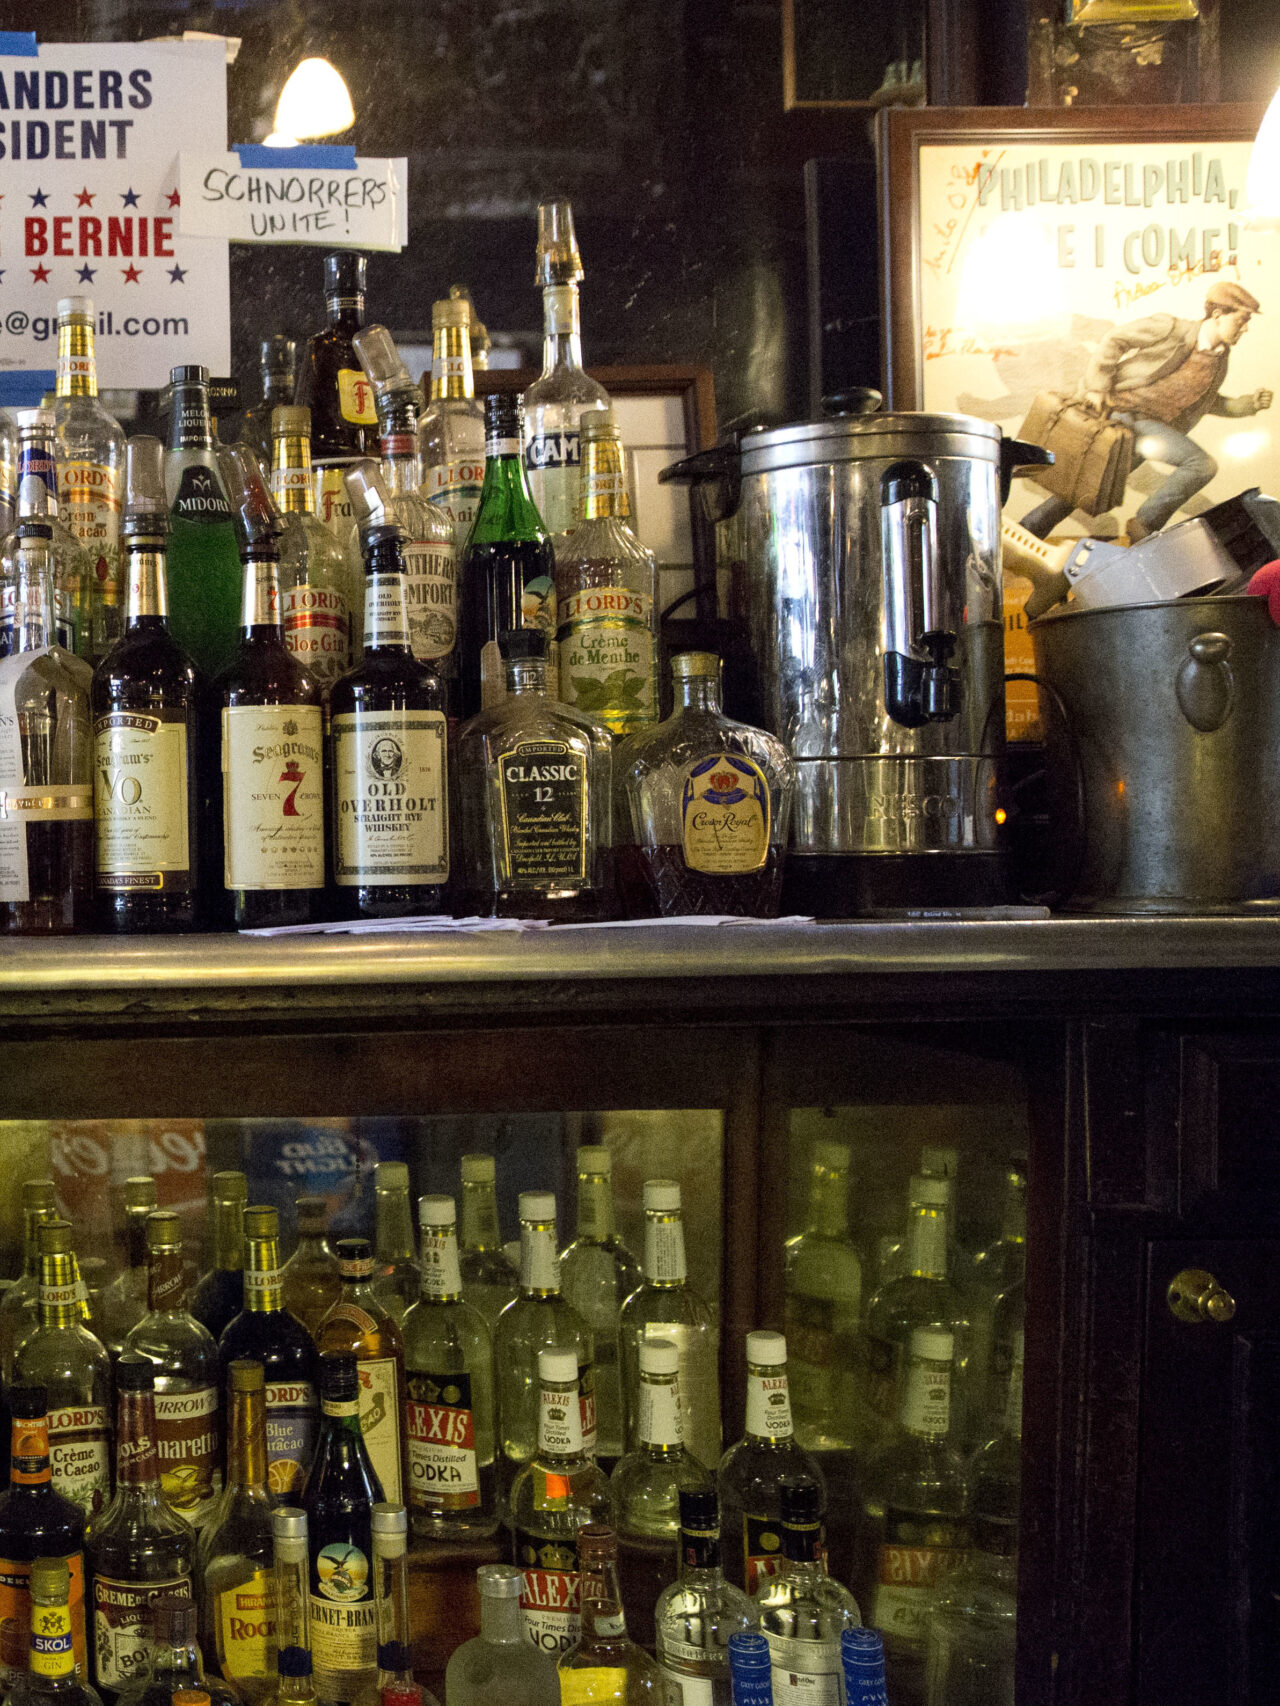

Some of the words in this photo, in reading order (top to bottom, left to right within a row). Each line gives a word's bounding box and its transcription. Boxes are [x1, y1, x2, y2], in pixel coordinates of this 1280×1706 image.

[202, 168, 387, 210] SCHNORRERS
[24, 216, 175, 257] BERNIE
[1123, 222, 1239, 275] COME!
[437, 465, 485, 488] LLOR
[178, 498, 231, 512] MIDORI
[406, 554, 455, 580] UTHERN
[406, 583, 454, 605] MFORT
[321, 634, 344, 652] Gin
[580, 634, 629, 650] Crème
[587, 651, 640, 665] Menthe
[520, 671, 537, 684] 12
[507, 765, 577, 782] CLASSIC
[251, 793, 281, 801] SEVEN
[279, 772, 306, 816] 7
[368, 783, 406, 797] OLD
[534, 787, 554, 802] 12
[341, 798, 437, 813] OVERHOLT
[354, 813, 401, 823] STRAIGHT
[404, 812, 423, 822] RYE
[692, 811, 722, 831] Crown
[721, 811, 754, 832] Royal
[365, 823, 411, 833] WHISKEY
[124, 876, 156, 886] FINEST
[266, 1385, 310, 1404] ORD'S
[542, 1393, 570, 1406] ALEXIS
[48, 1408, 104, 1430] LORD'S
[408, 1404, 468, 1444] LEXIS
[266, 1423, 294, 1437] Blue
[544, 1434, 571, 1445] VODKA
[53, 1447, 94, 1464] Crème
[65, 1461, 100, 1477] Cacao
[411, 1461, 462, 1483] ODKA
[525, 1615, 540, 1627] Four
[542, 1621, 566, 1632] Times
[35, 1638, 69, 1651] SKOL
[43, 1661, 63, 1670] GIN
